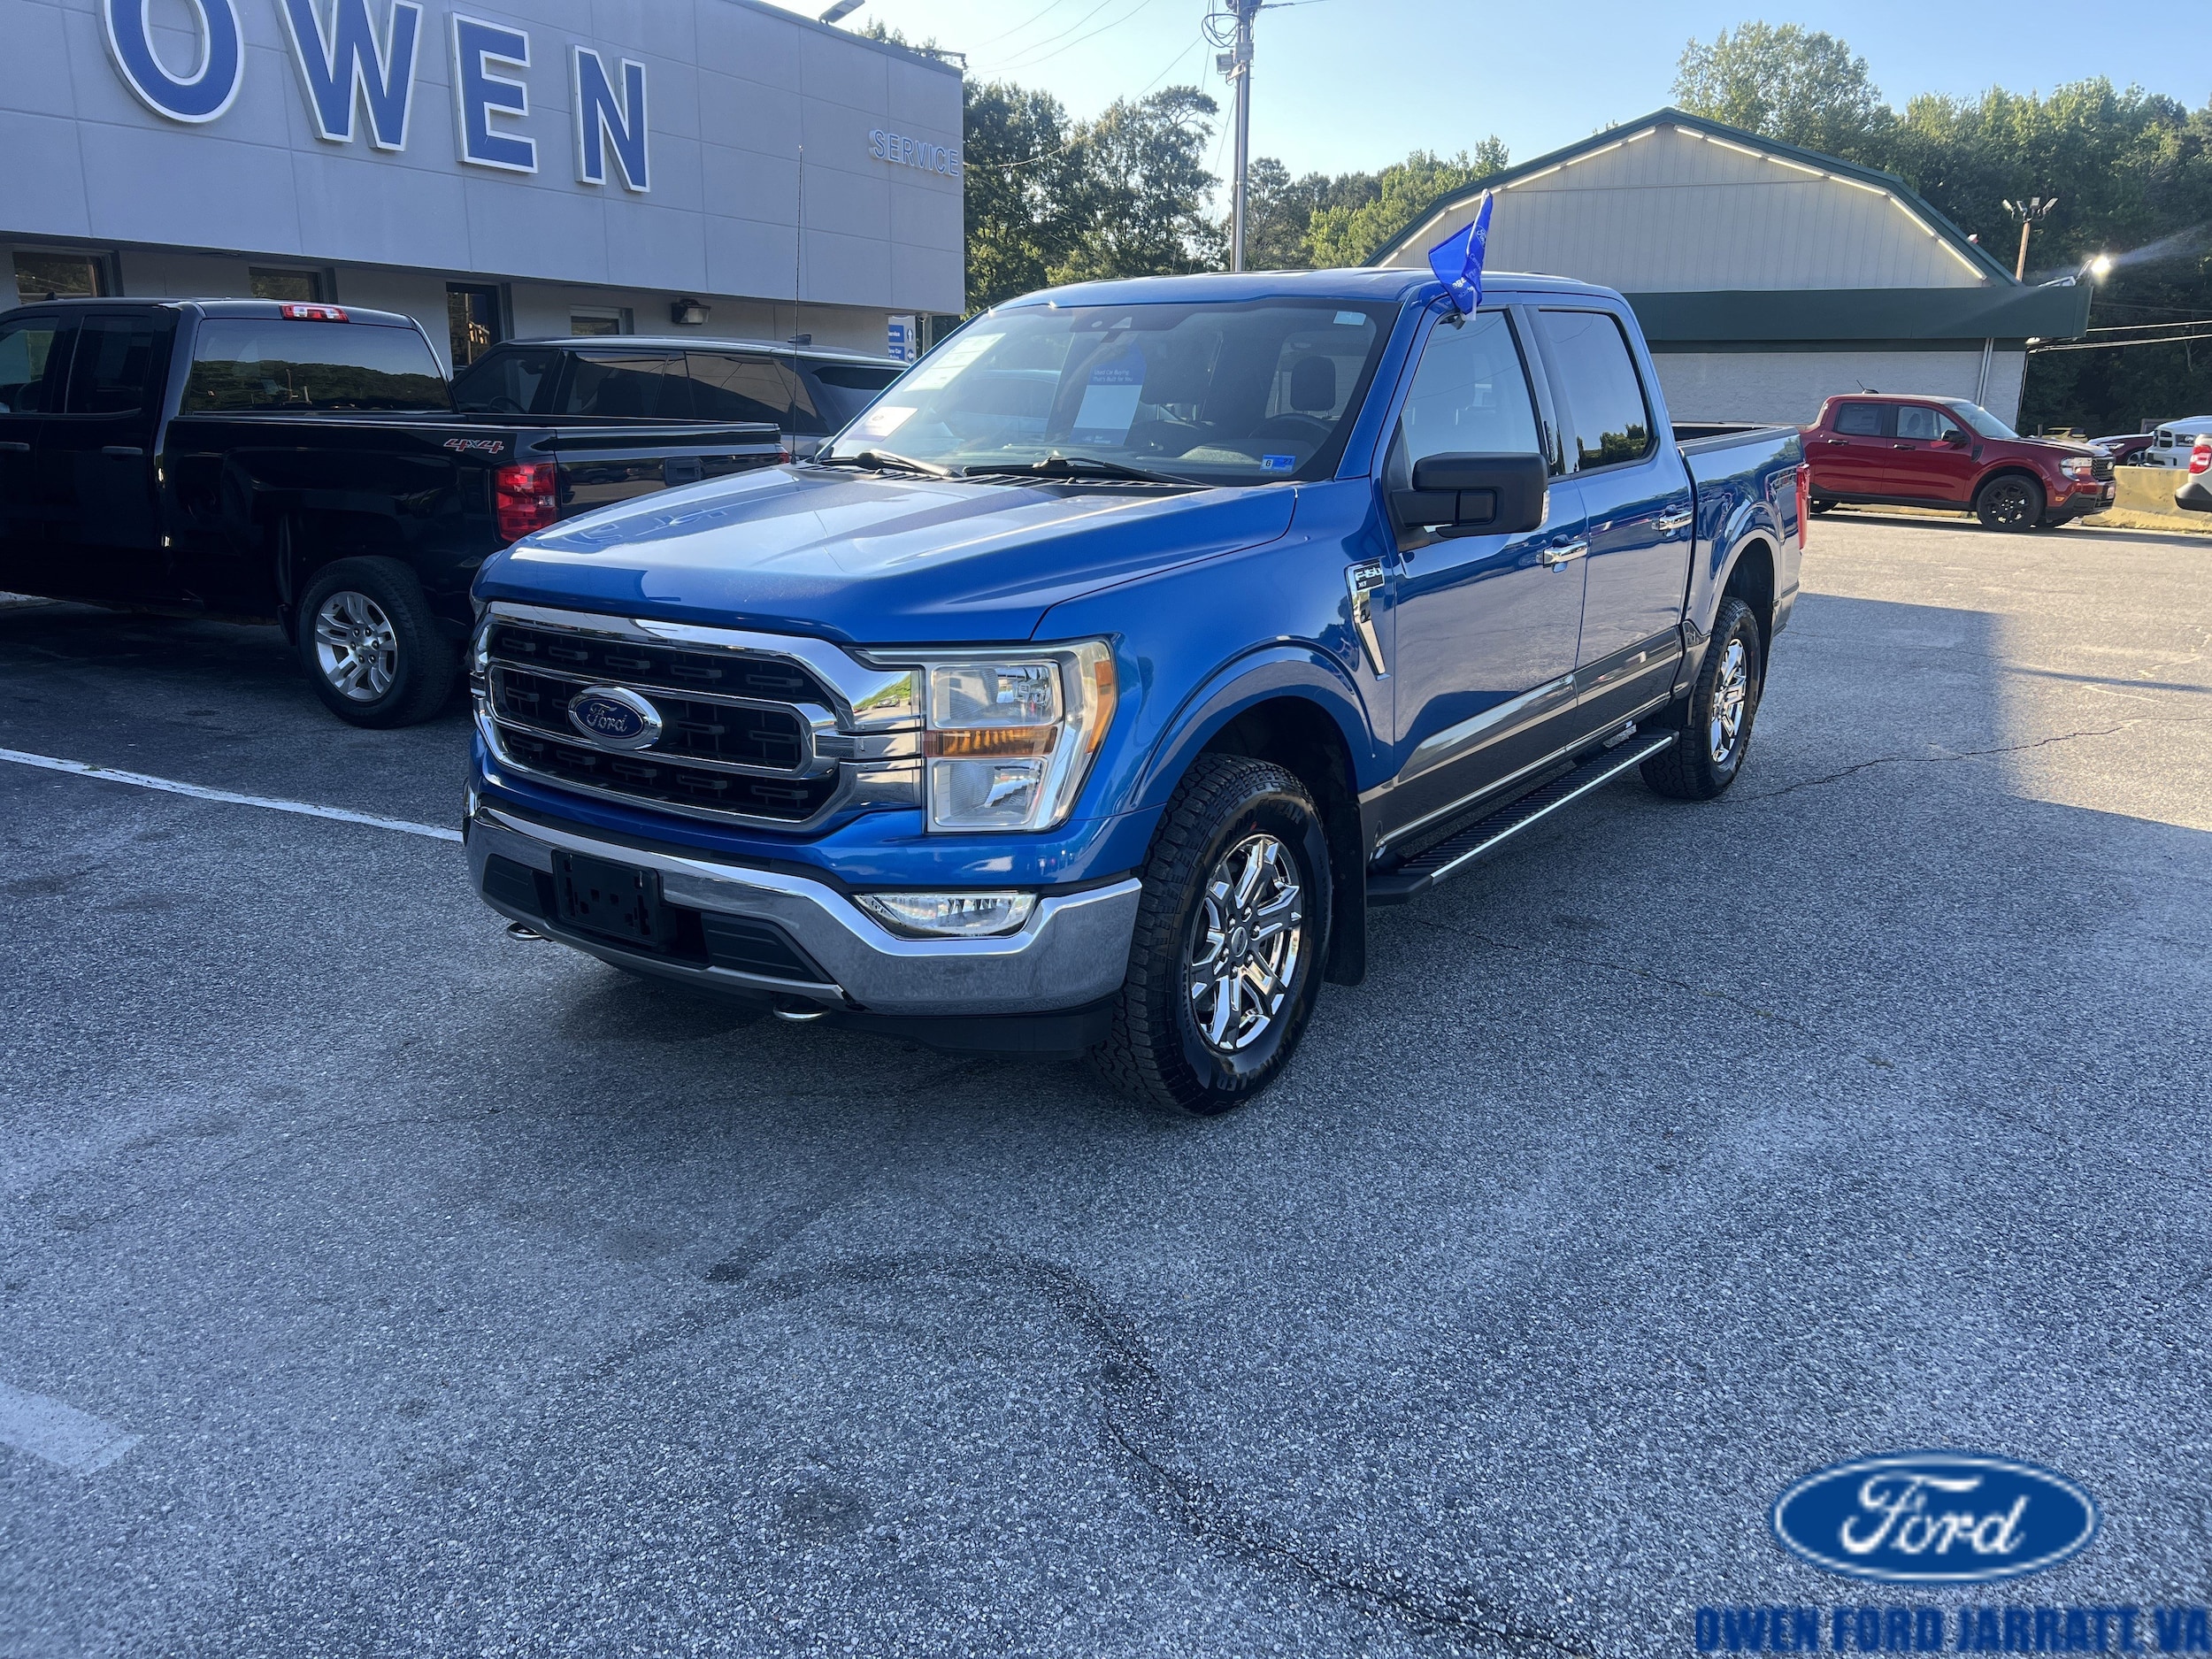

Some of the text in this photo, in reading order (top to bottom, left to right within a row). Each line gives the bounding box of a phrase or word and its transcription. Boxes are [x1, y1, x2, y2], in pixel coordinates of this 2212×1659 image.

[101, 0, 649, 193] OWEN
[872, 129, 959, 177] SERVICE
[586, 703, 628, 733] Ford
